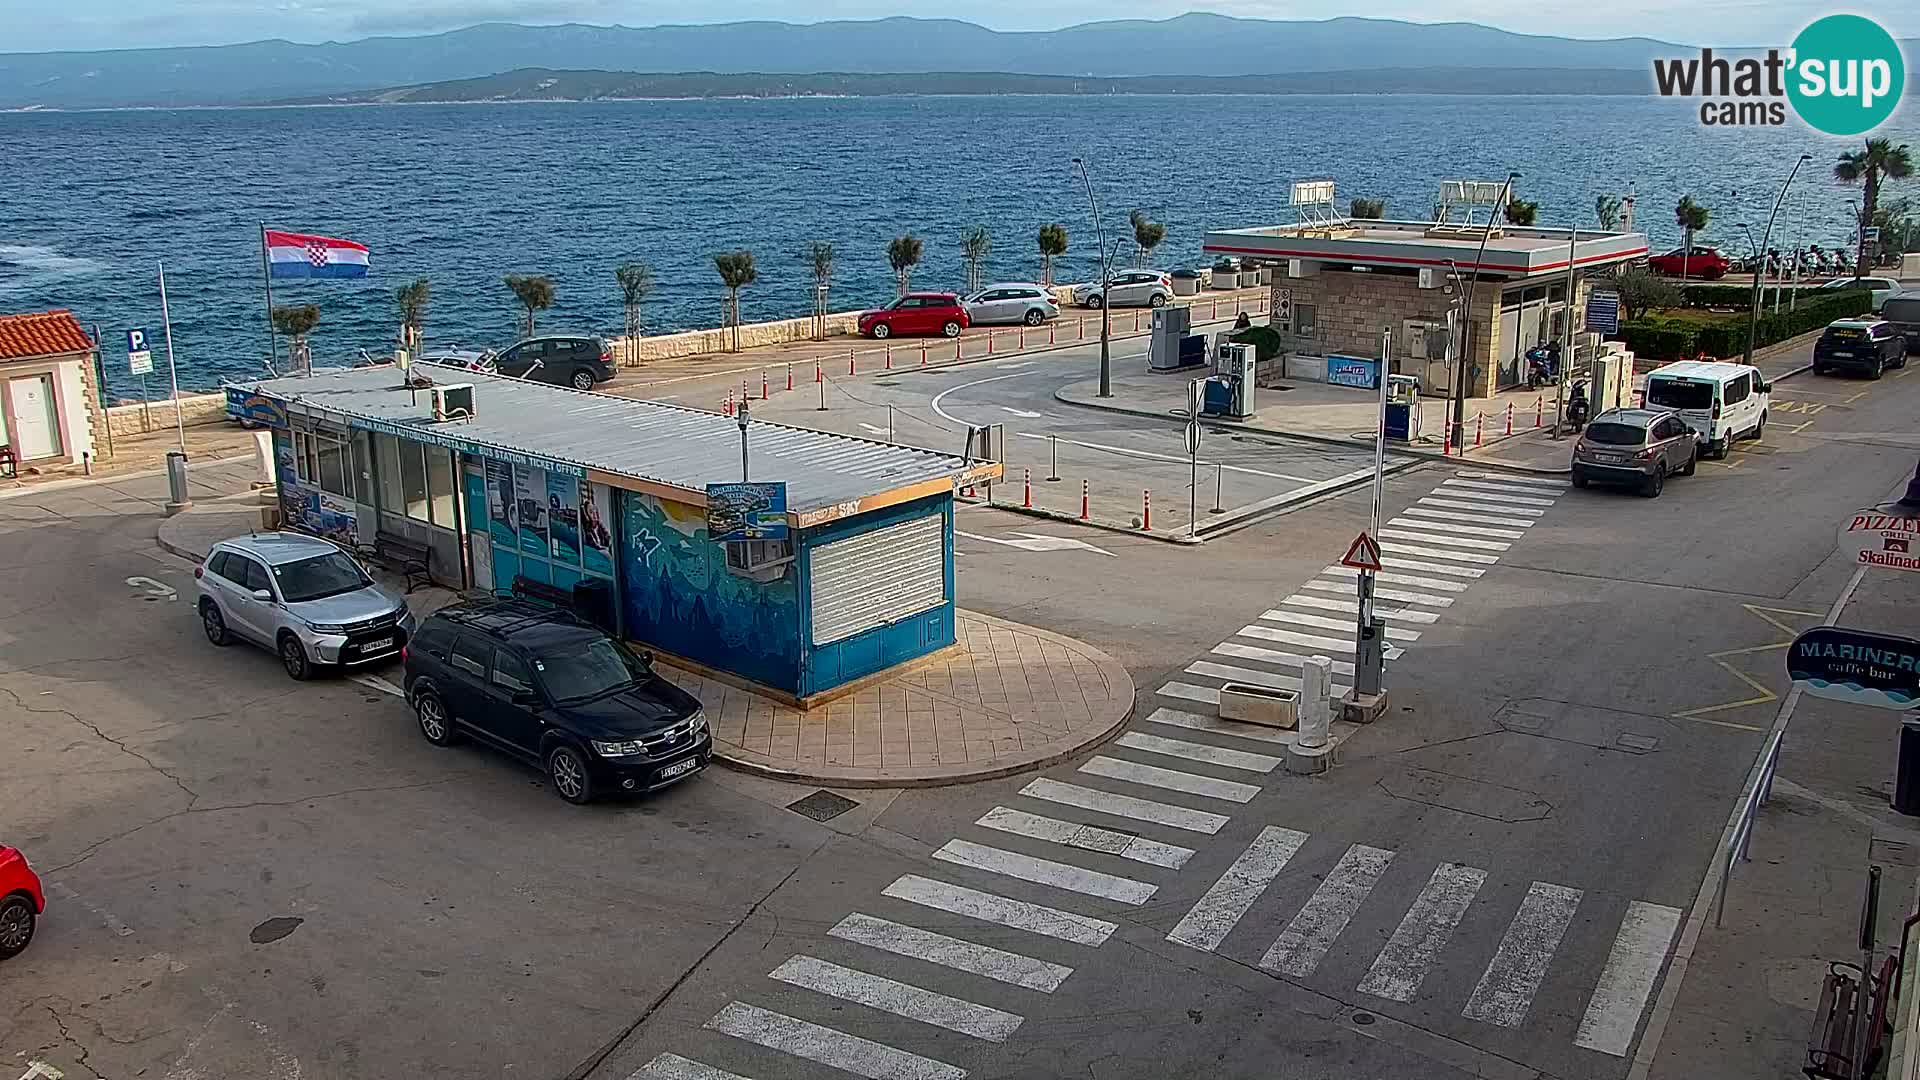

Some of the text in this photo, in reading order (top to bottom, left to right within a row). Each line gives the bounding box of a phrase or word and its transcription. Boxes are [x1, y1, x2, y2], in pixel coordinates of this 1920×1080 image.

[131, 331, 144, 350] P
[437, 437, 469, 451] POSTAJA
[479, 446, 494, 458] BUS
[495, 449, 527, 465] STATION
[529, 457, 555, 470] TICKET
[556, 462, 583, 477] OFFICE
[1847, 515, 1920, 535] PIZZE
[1880, 530, 1917, 541] GRILL
[1828, 663, 1896, 680] caffe bar
